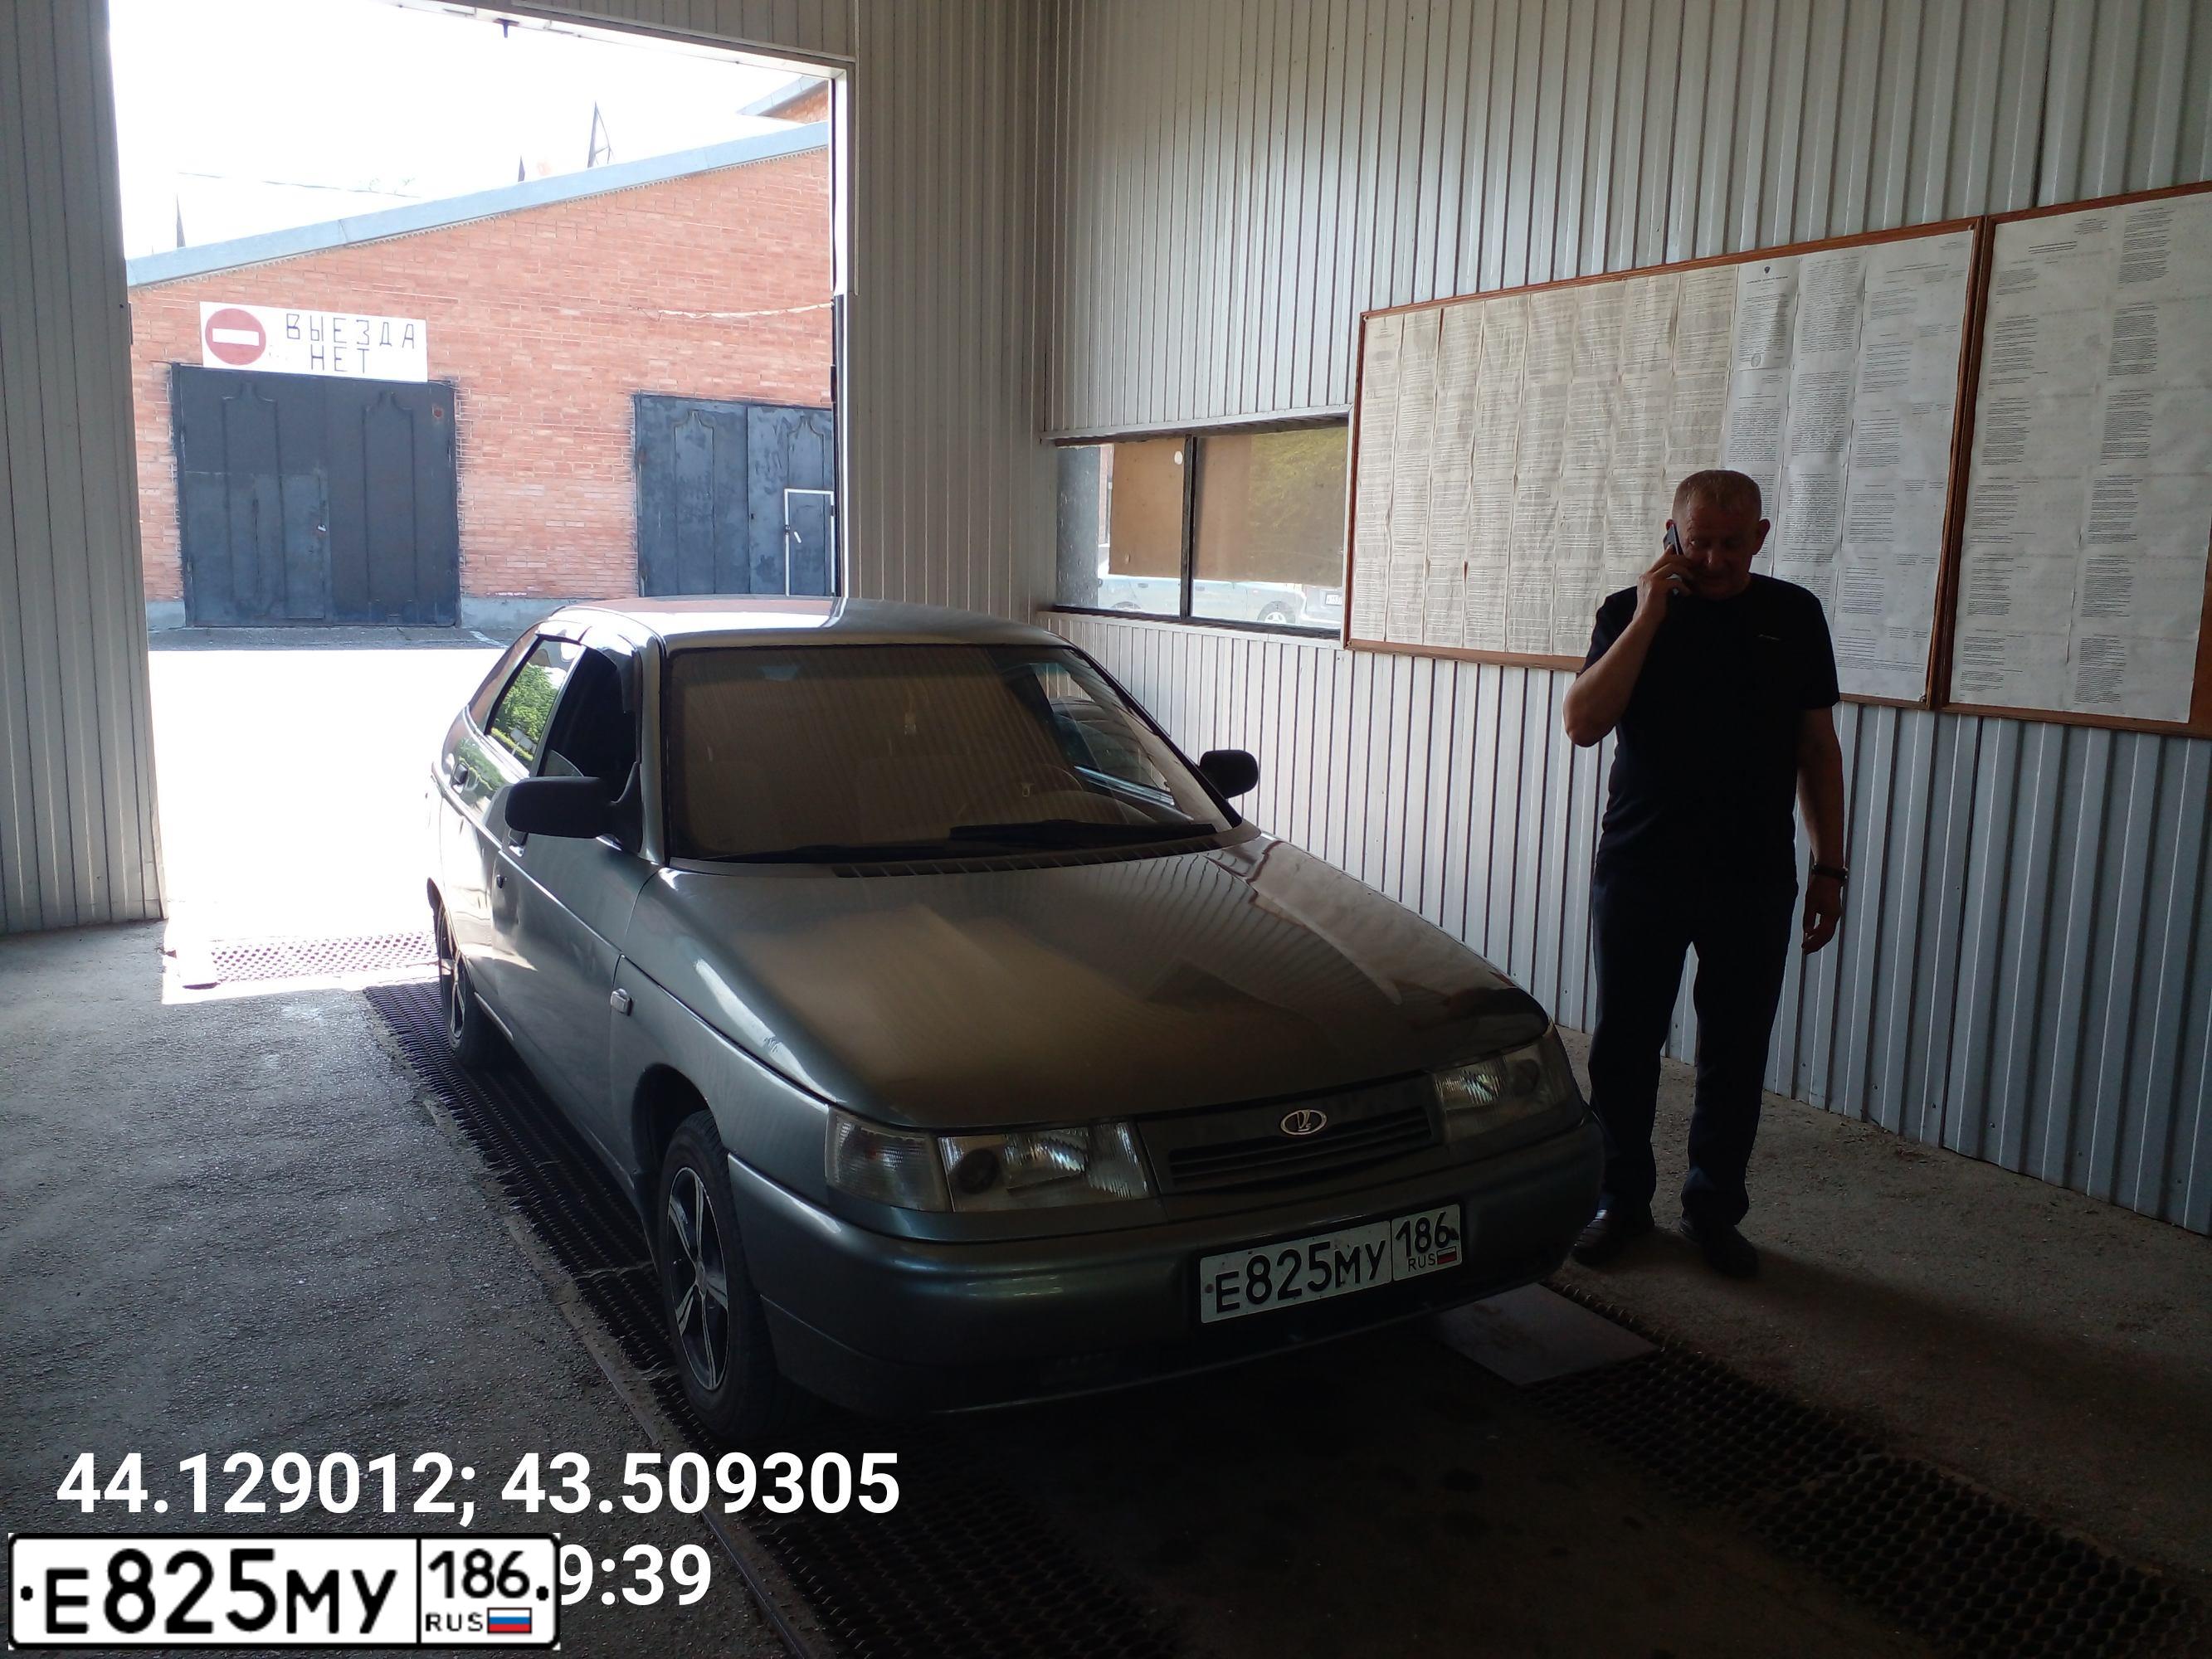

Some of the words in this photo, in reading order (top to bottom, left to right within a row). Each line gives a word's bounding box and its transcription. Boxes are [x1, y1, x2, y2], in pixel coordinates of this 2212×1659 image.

[286, 313, 415, 349] ВЫЕЗДА
[310, 343, 370, 373] НЕТ
[1396, 1211, 1449, 1258] 186
[1408, 1253, 1436, 1272] RUS
